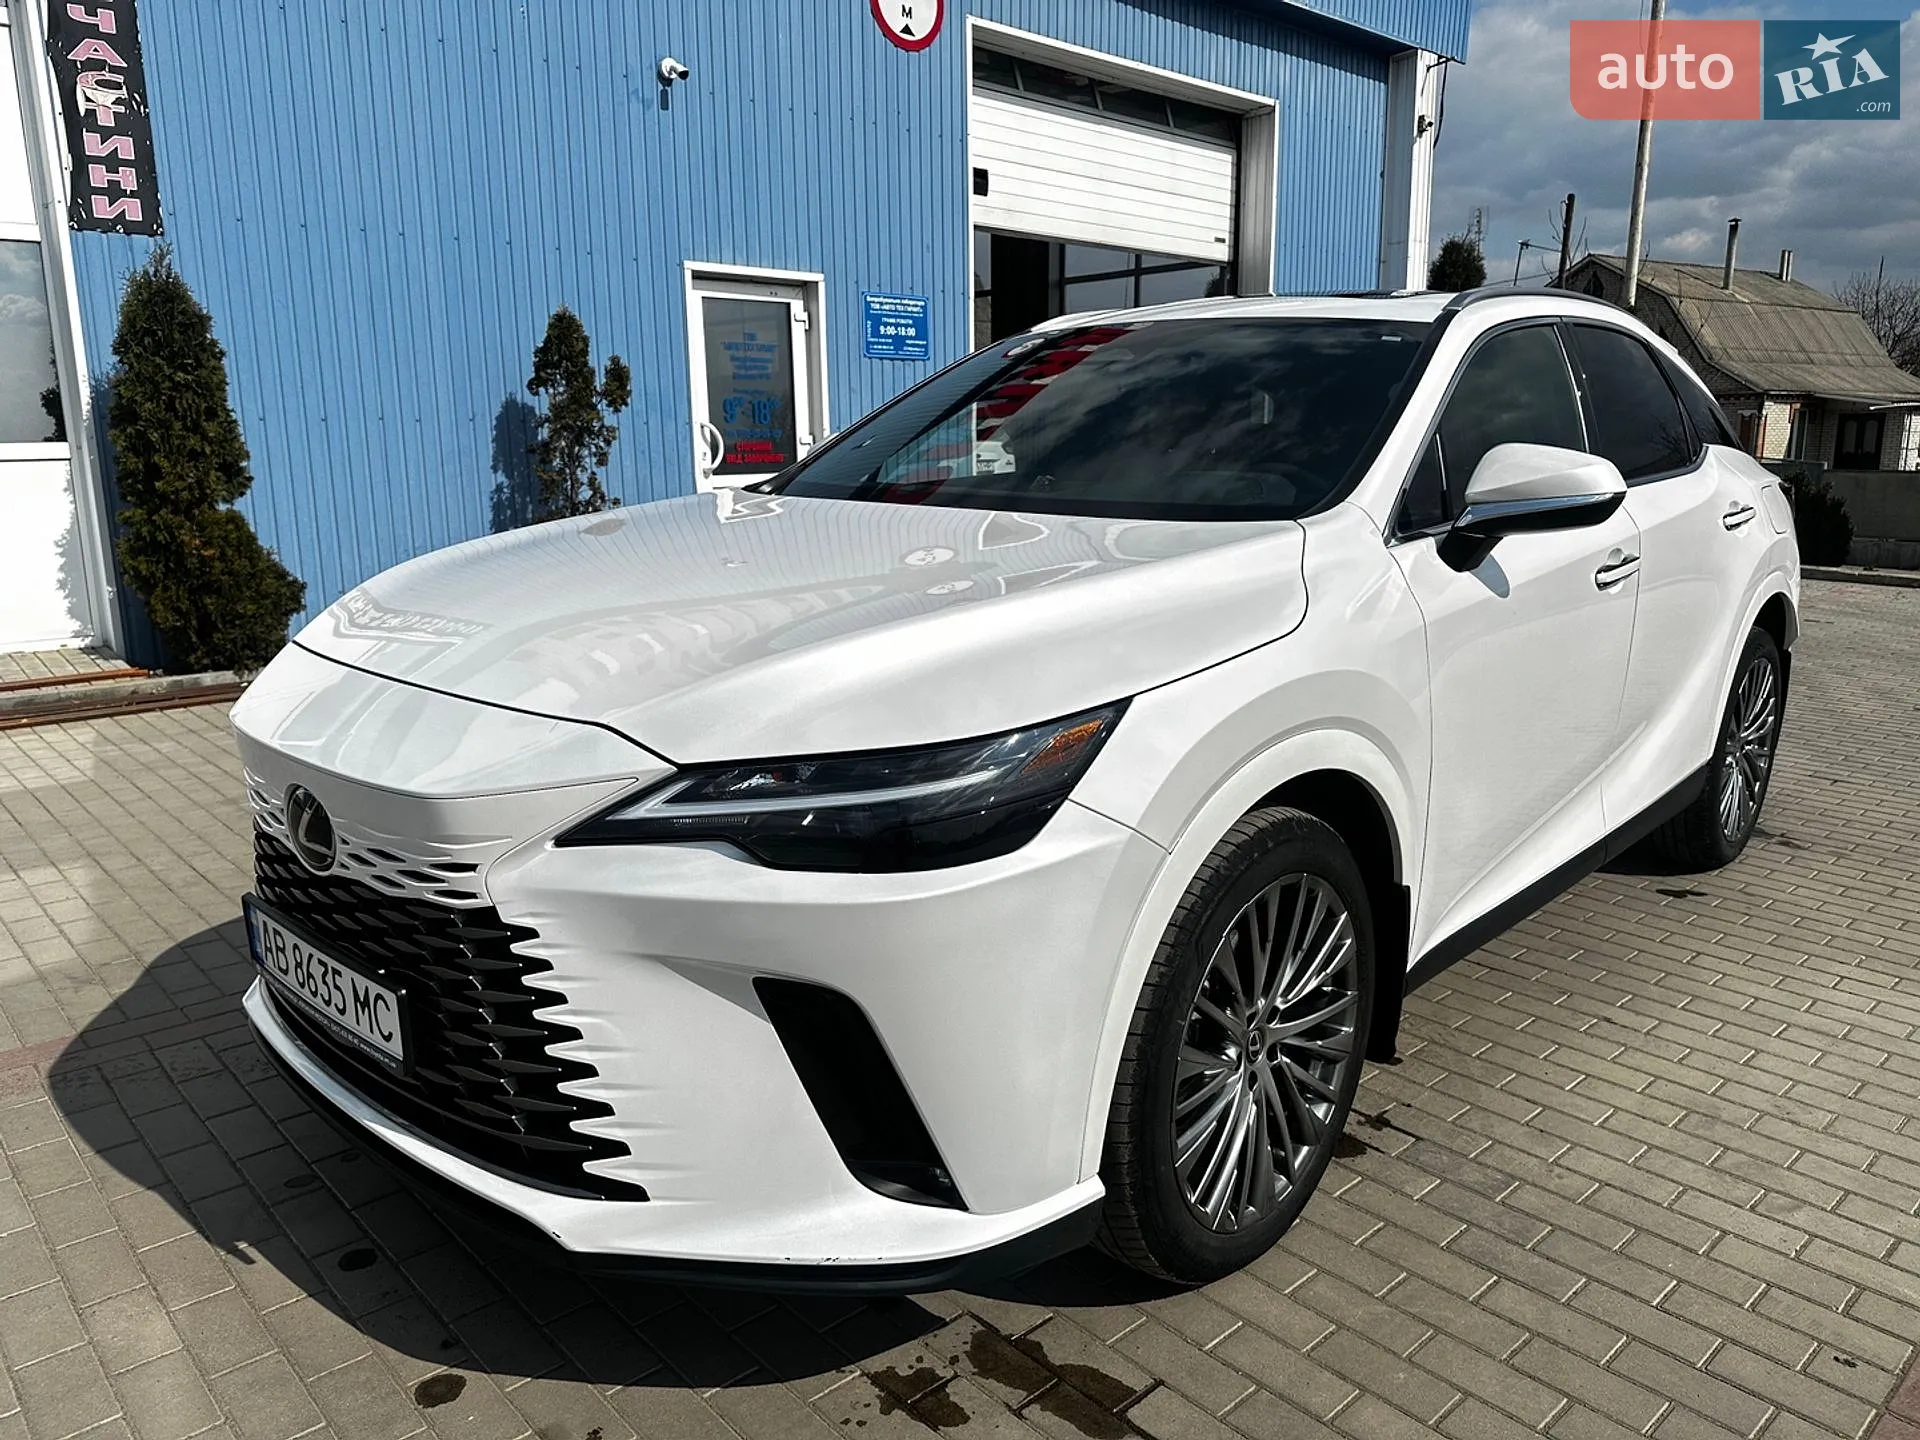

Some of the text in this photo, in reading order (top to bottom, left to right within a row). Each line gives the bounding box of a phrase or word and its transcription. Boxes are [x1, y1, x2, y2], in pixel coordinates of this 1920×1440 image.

[879, 325, 916, 337] 9:00-18:00
[262, 919, 289, 977] AB
[292, 942, 347, 1017] 8635
[351, 976, 394, 1044] MC
